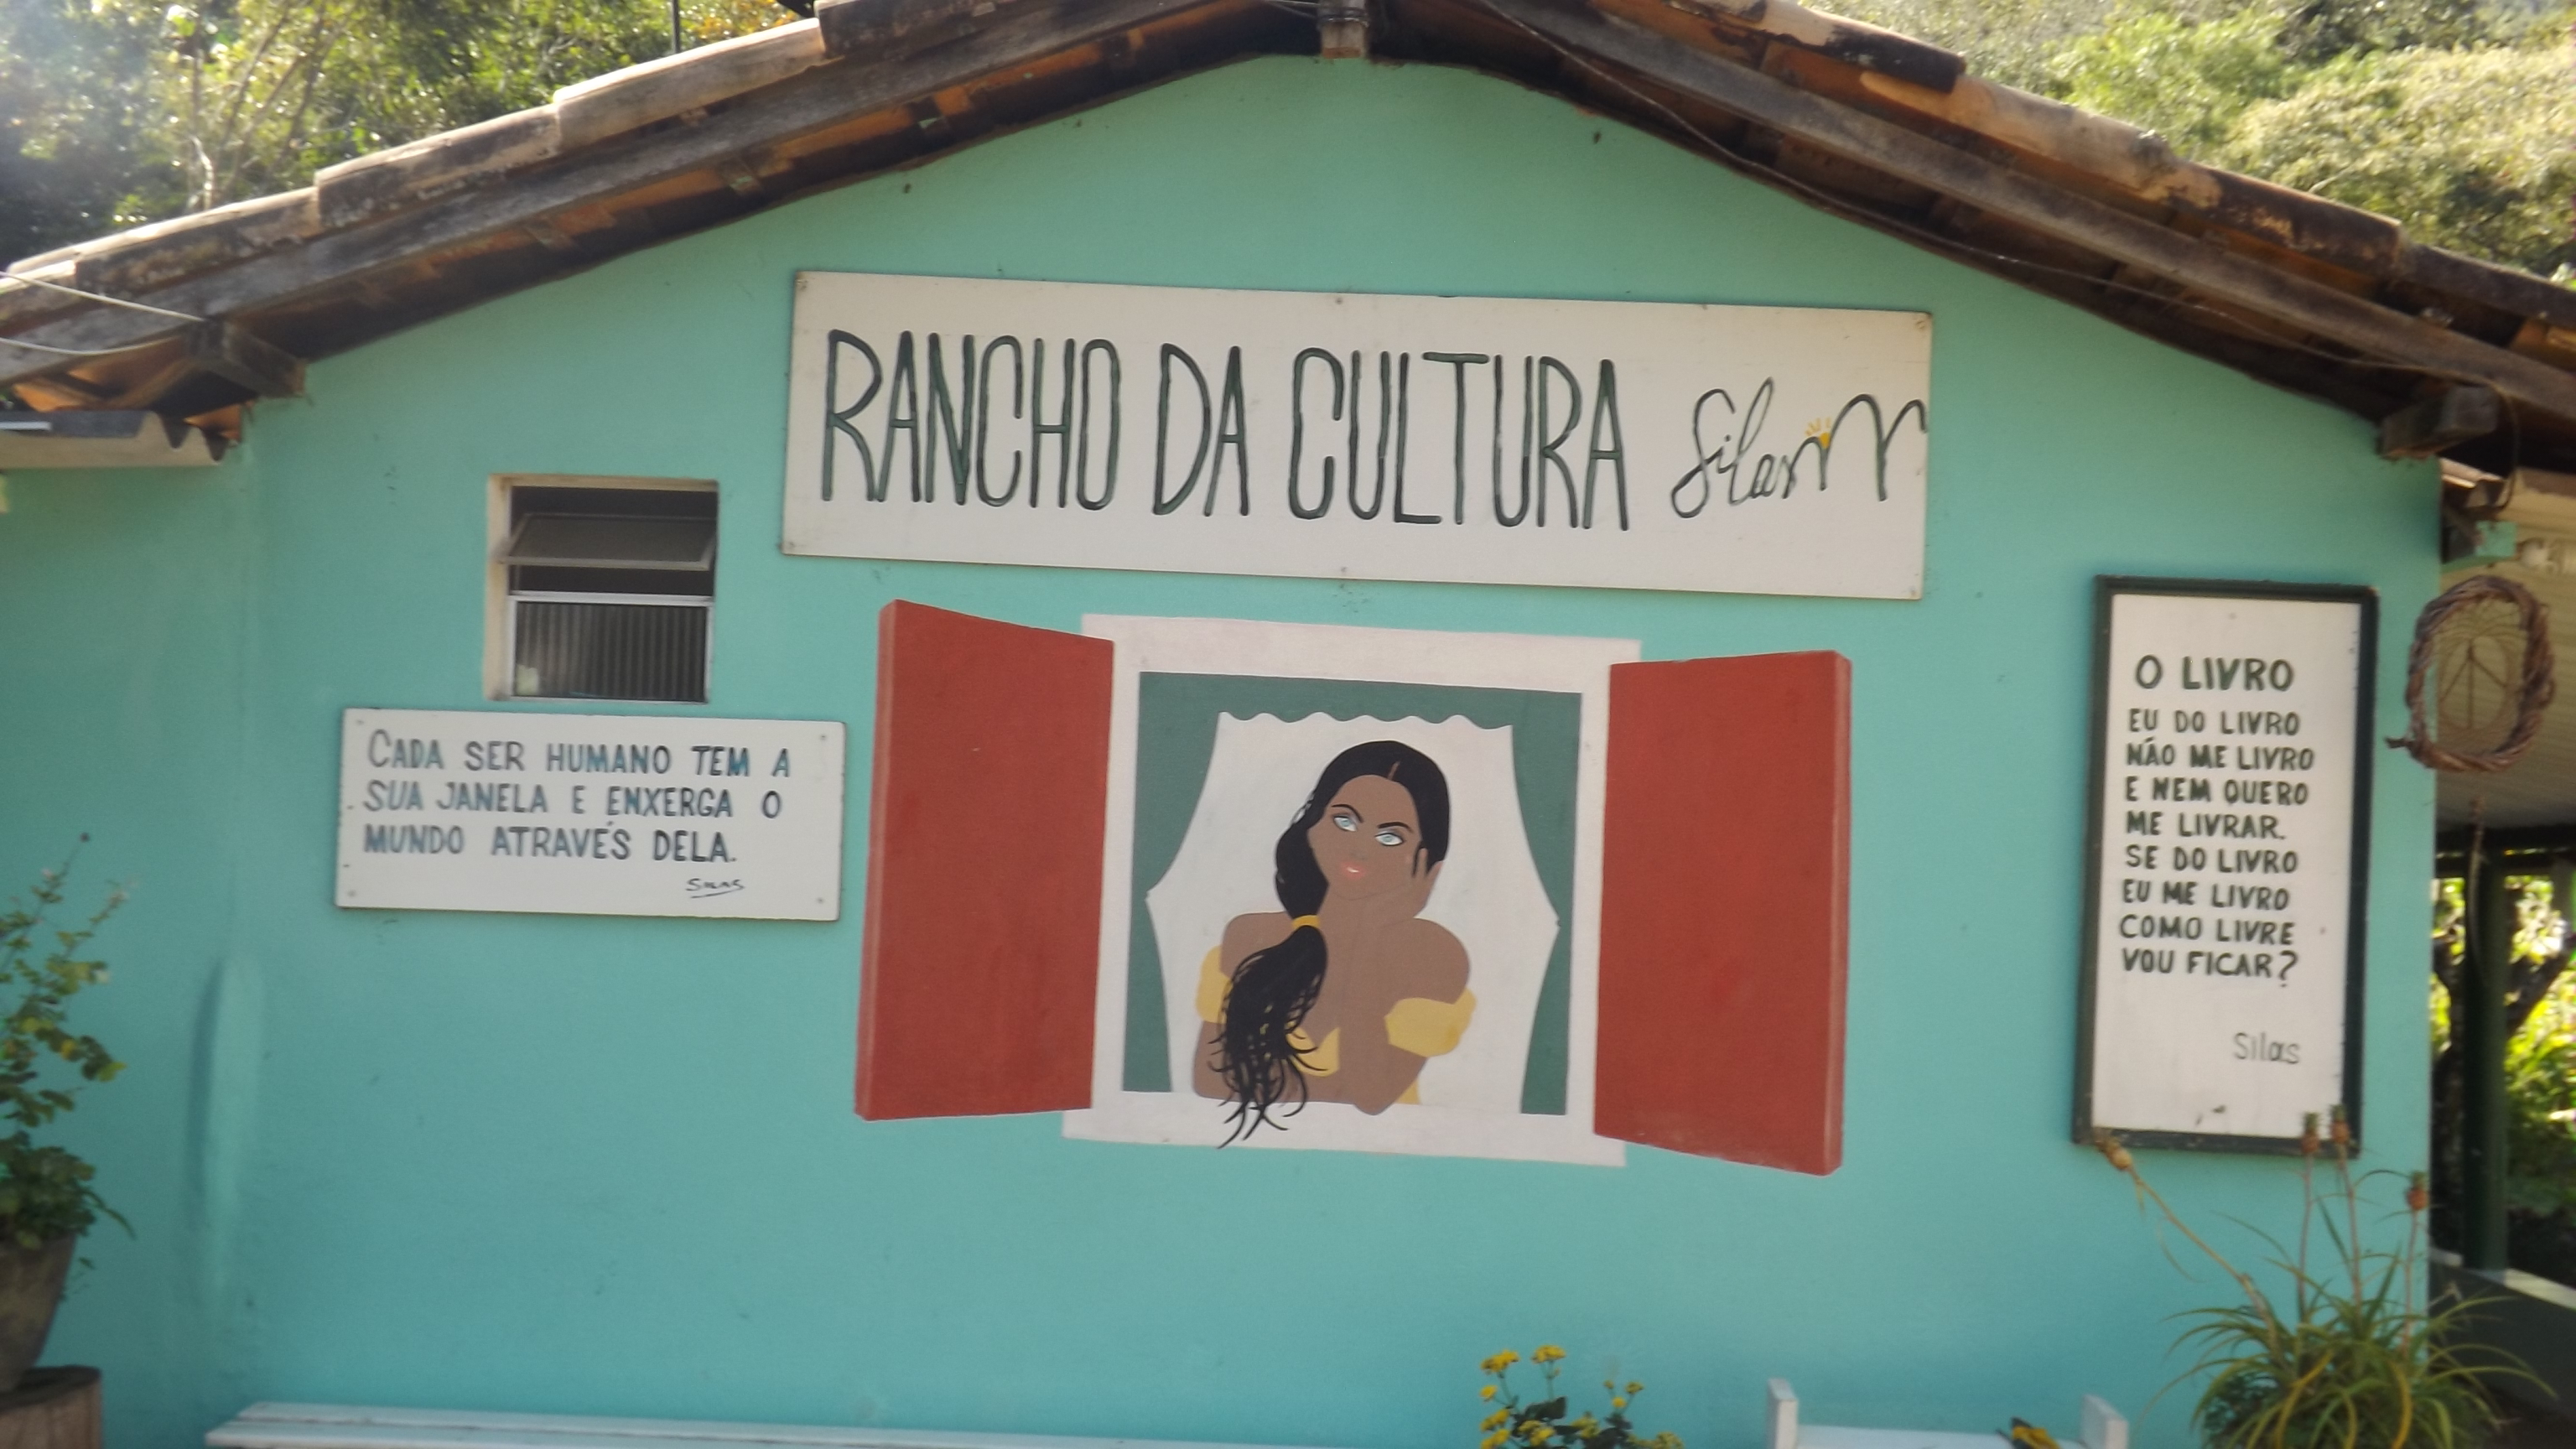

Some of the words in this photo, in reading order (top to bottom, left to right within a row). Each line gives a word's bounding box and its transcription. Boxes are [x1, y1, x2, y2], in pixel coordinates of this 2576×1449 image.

[822, 329, 1120, 511] RANCHO
[1152, 343, 1249, 517] DA
[1288, 347, 1629, 531] CULTURA
[2135, 655, 2162, 689] O
[2182, 657, 2293, 692] LIVRO
[2128, 709, 2158, 733] EU
[2175, 711, 2205, 734] DO
[2220, 710, 2299, 736] LIVRO
[367, 729, 444, 769] CADA
[464, 740, 525, 771] SER
[546, 742, 672, 776] HUMANO
[692, 745, 750, 777] TEM
[771, 747, 791, 777] A
[2190, 744, 2227, 769] ME
[2237, 745, 2314, 771] LIVRO
[363, 780, 423, 812] SUA
[436, 782, 548, 813] JANELA
[572, 785, 586, 814] E
[606, 785, 733, 818] ENXERGA
[761, 790, 782, 818] O
[2126, 776, 2138, 802] E
[2153, 779, 2212, 803] NEM
[2127, 811, 2162, 836] ME
[2179, 813, 2286, 840] LIVRAR.
[364, 823, 465, 854] MUNDO
[491, 821, 631, 860] ATRAVÉS
[652, 829, 738, 864] DELA.
[2126, 845, 2158, 870] SE
[2174, 846, 2207, 872] DO
[2218, 849, 2298, 875] LIVRO
[2122, 880, 2151, 904] EU
[2162, 880, 2197, 906] ME
[2212, 885, 2289, 911] LIVRO
[2120, 914, 2202, 940] COMO
[2217, 917, 2295, 946] LIVRE
[2122, 949, 2174, 974] VOU
[2187, 950, 2298, 988] FICAR?
